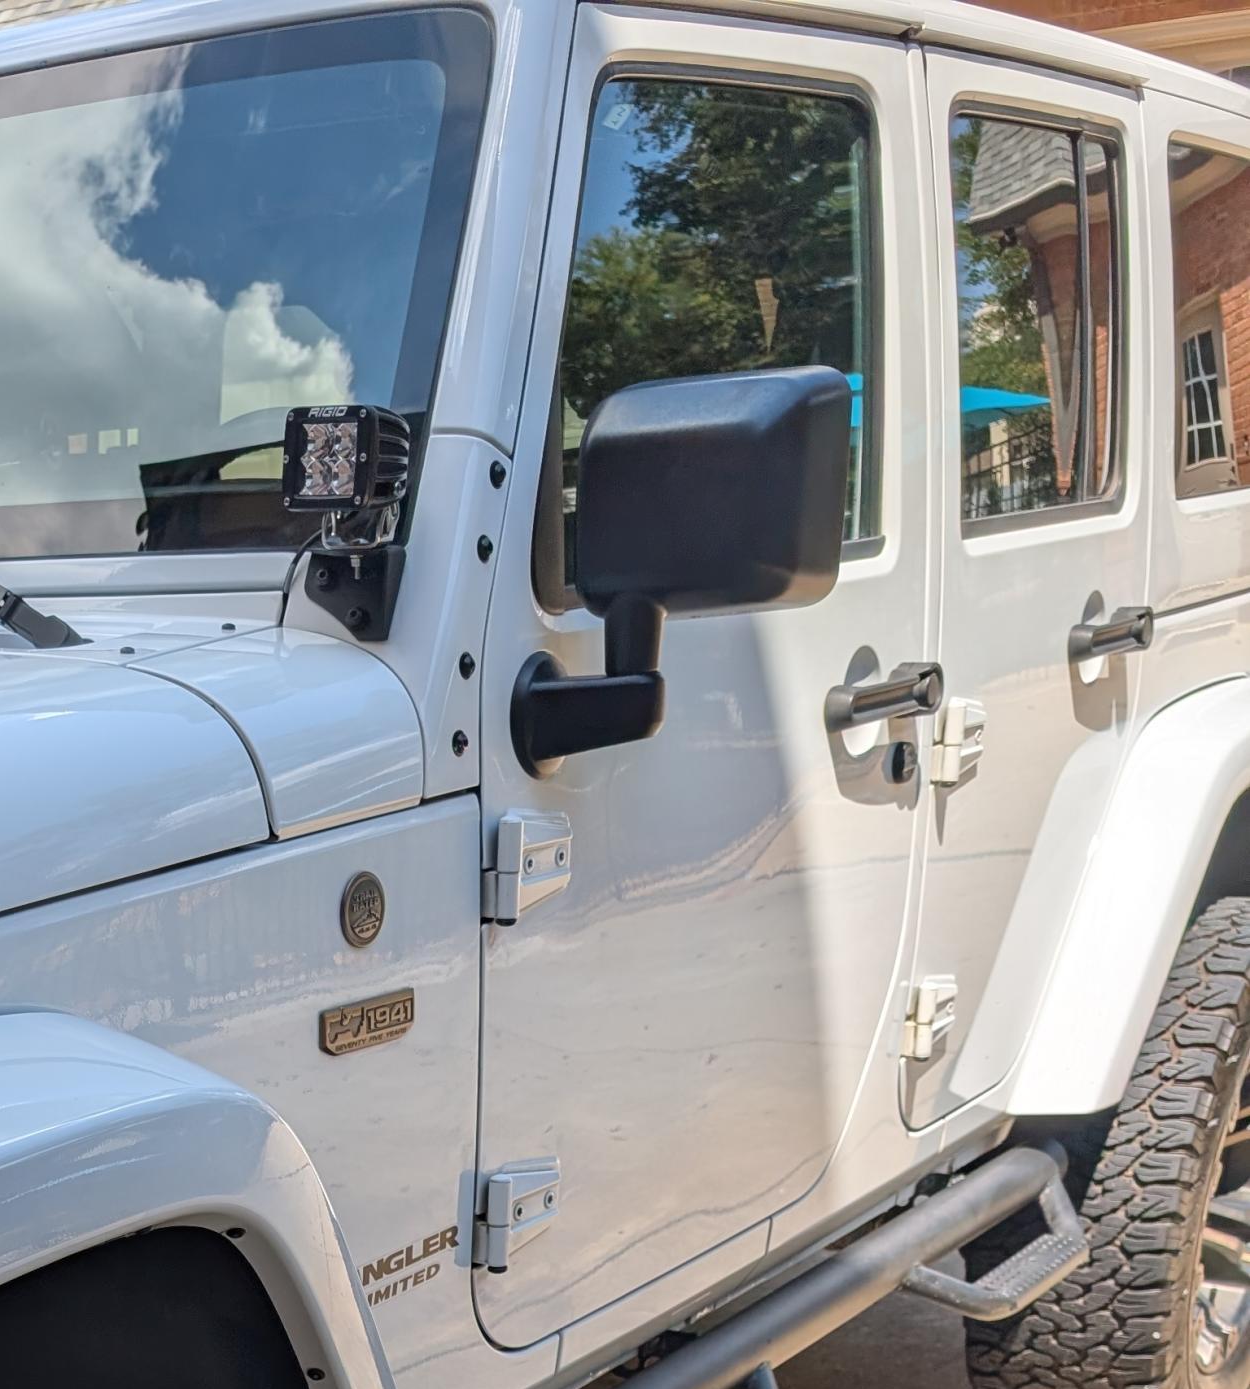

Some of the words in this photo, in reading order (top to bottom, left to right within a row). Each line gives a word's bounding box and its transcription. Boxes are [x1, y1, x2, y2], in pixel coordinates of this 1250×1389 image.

[308, 406, 348, 418] RIGID
[353, 889, 377, 902] TRAIL
[353, 898, 380, 912] RATED
[366, 1000, 413, 1032] 1941
[335, 1038, 367, 1052] SEVENTY
[369, 1033, 383, 1043] FIVE
[358, 1225, 459, 1287] NGLER
